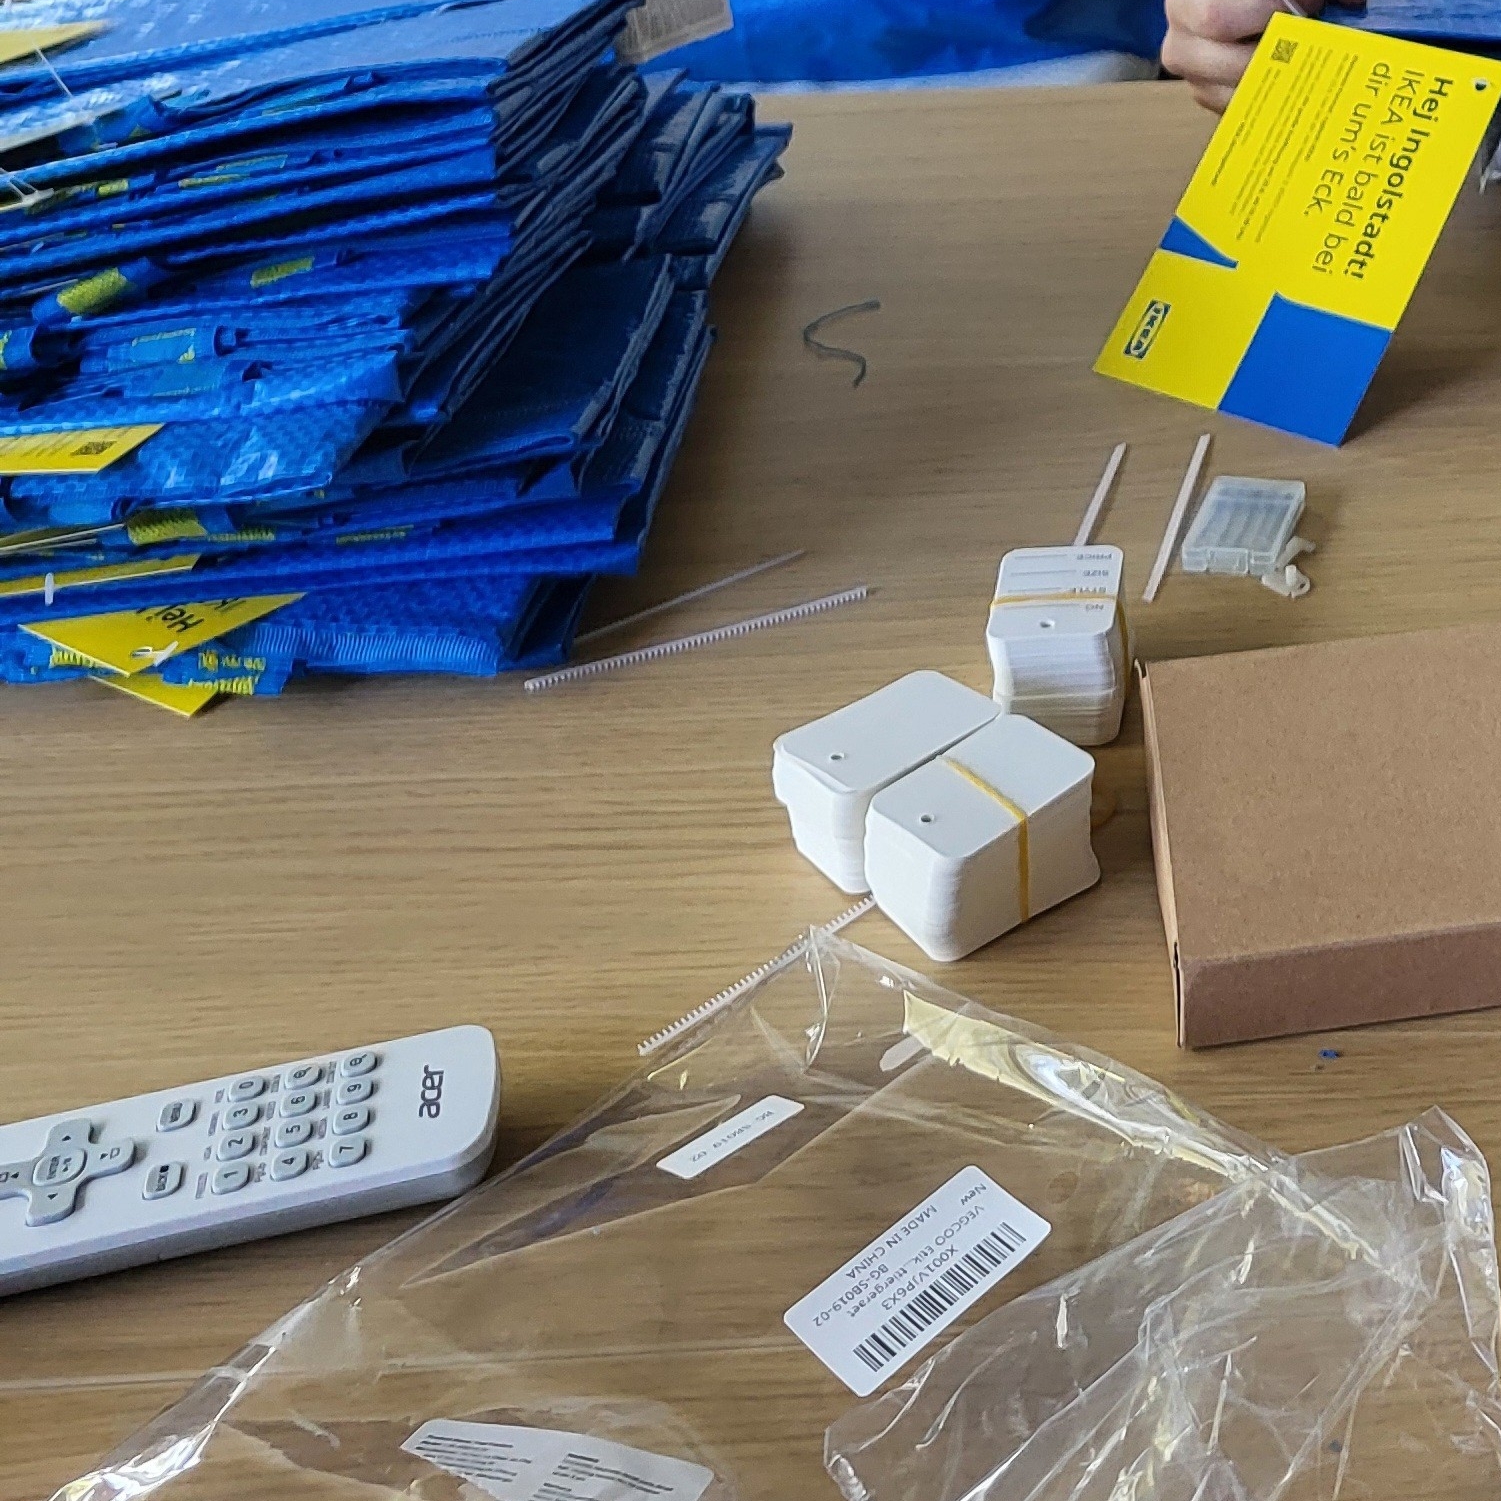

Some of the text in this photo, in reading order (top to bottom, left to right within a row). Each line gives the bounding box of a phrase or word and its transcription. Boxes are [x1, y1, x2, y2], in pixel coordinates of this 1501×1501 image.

[1303, 61, 1395, 217] dir um's Eck.
[1311, 68, 1425, 276] IKEA ist bald bei
[1342, 76, 1453, 280] Hej Ingolstadt!
[1129, 303, 1166, 357] IKEA
[237, 1080, 256, 1090] 0
[290, 1095, 306, 1105] 6
[346, 1082, 363, 1093] 9
[418, 1064, 445, 1119] acer
[232, 1107, 249, 1118] 3
[285, 1124, 301, 1135] 5
[343, 1111, 359, 1121] 8
[227, 1136, 244, 1148] 2
[960, 1183, 987, 1206] New
[845, 1204, 938, 1279] MADE IN CHINA
[934, 1205, 985, 1246] VEGCOO
[812, 1263, 889, 1327] BG-SB019-02
[881, 1244, 959, 1311] X001VJP6X3
